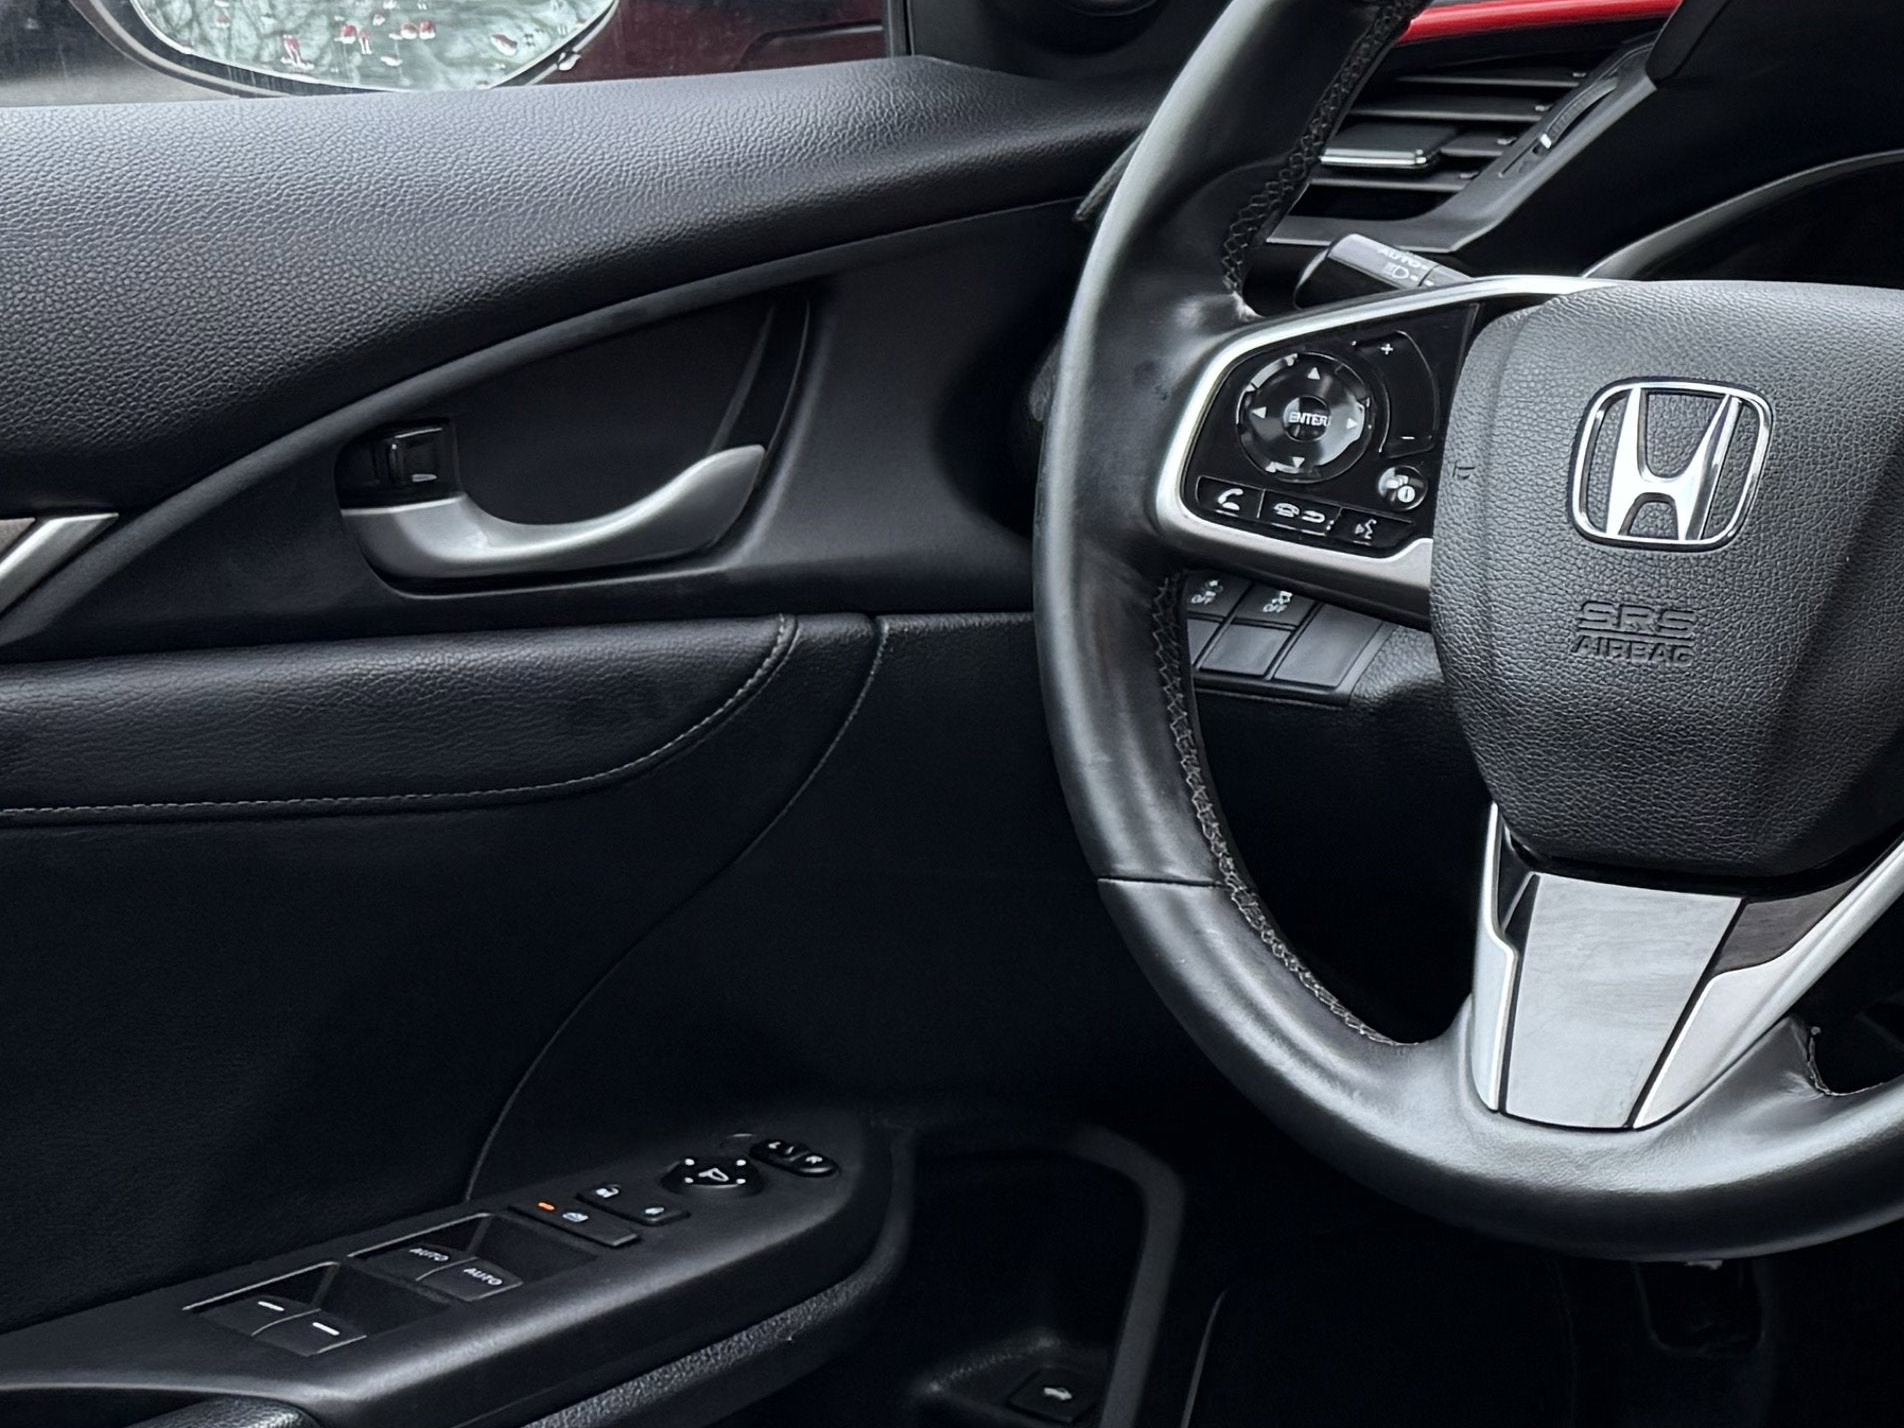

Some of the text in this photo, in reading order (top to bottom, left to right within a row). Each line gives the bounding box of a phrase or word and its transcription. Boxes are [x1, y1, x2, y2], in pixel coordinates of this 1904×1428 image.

[1288, 411, 1331, 427] ENTER
[1576, 600, 1697, 634] SRS
[1570, 635, 1696, 664] AIRBAG
[409, 1247, 449, 1262] AUTO
[463, 1267, 503, 1286] AUTO
